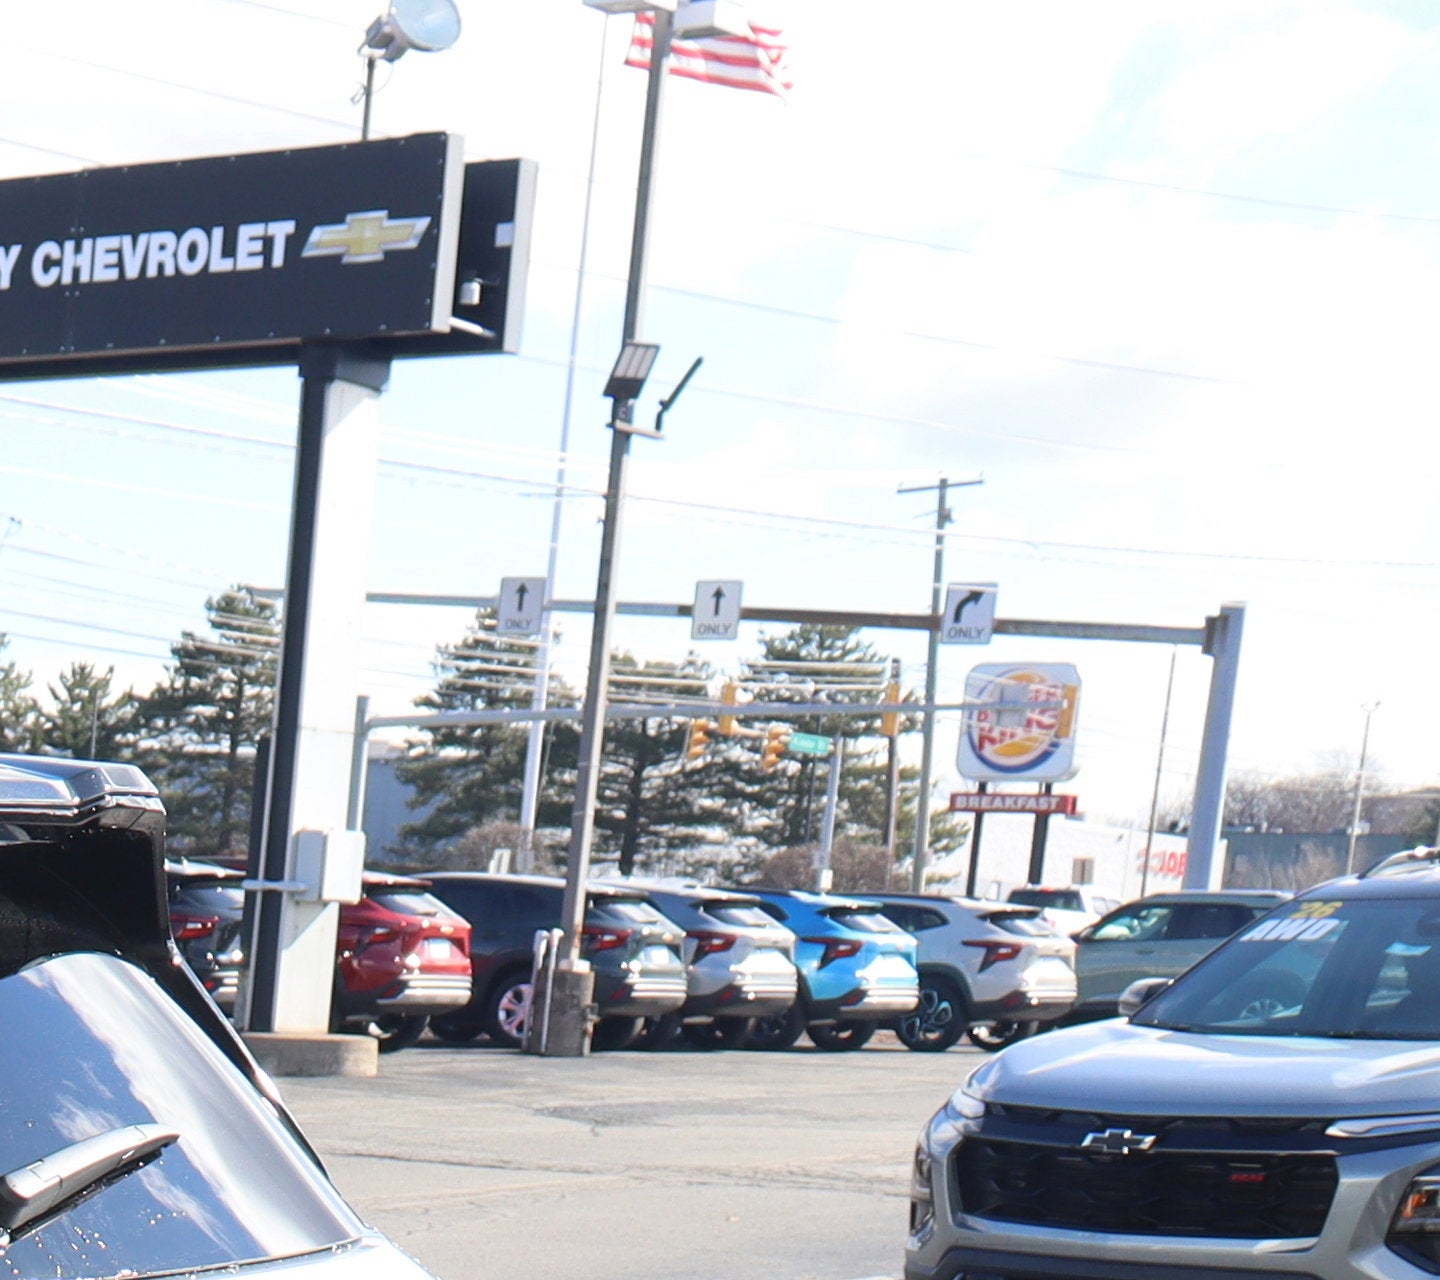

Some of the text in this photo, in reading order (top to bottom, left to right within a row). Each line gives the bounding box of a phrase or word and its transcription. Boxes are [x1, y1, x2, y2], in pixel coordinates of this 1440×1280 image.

[31, 219, 296, 288] CHEVROLET
[697, 622, 733, 635] ONLY
[948, 626, 986, 639] ONLY
[954, 794, 1061, 810] BREAKFAST
[1238, 918, 1341, 942] AWD
